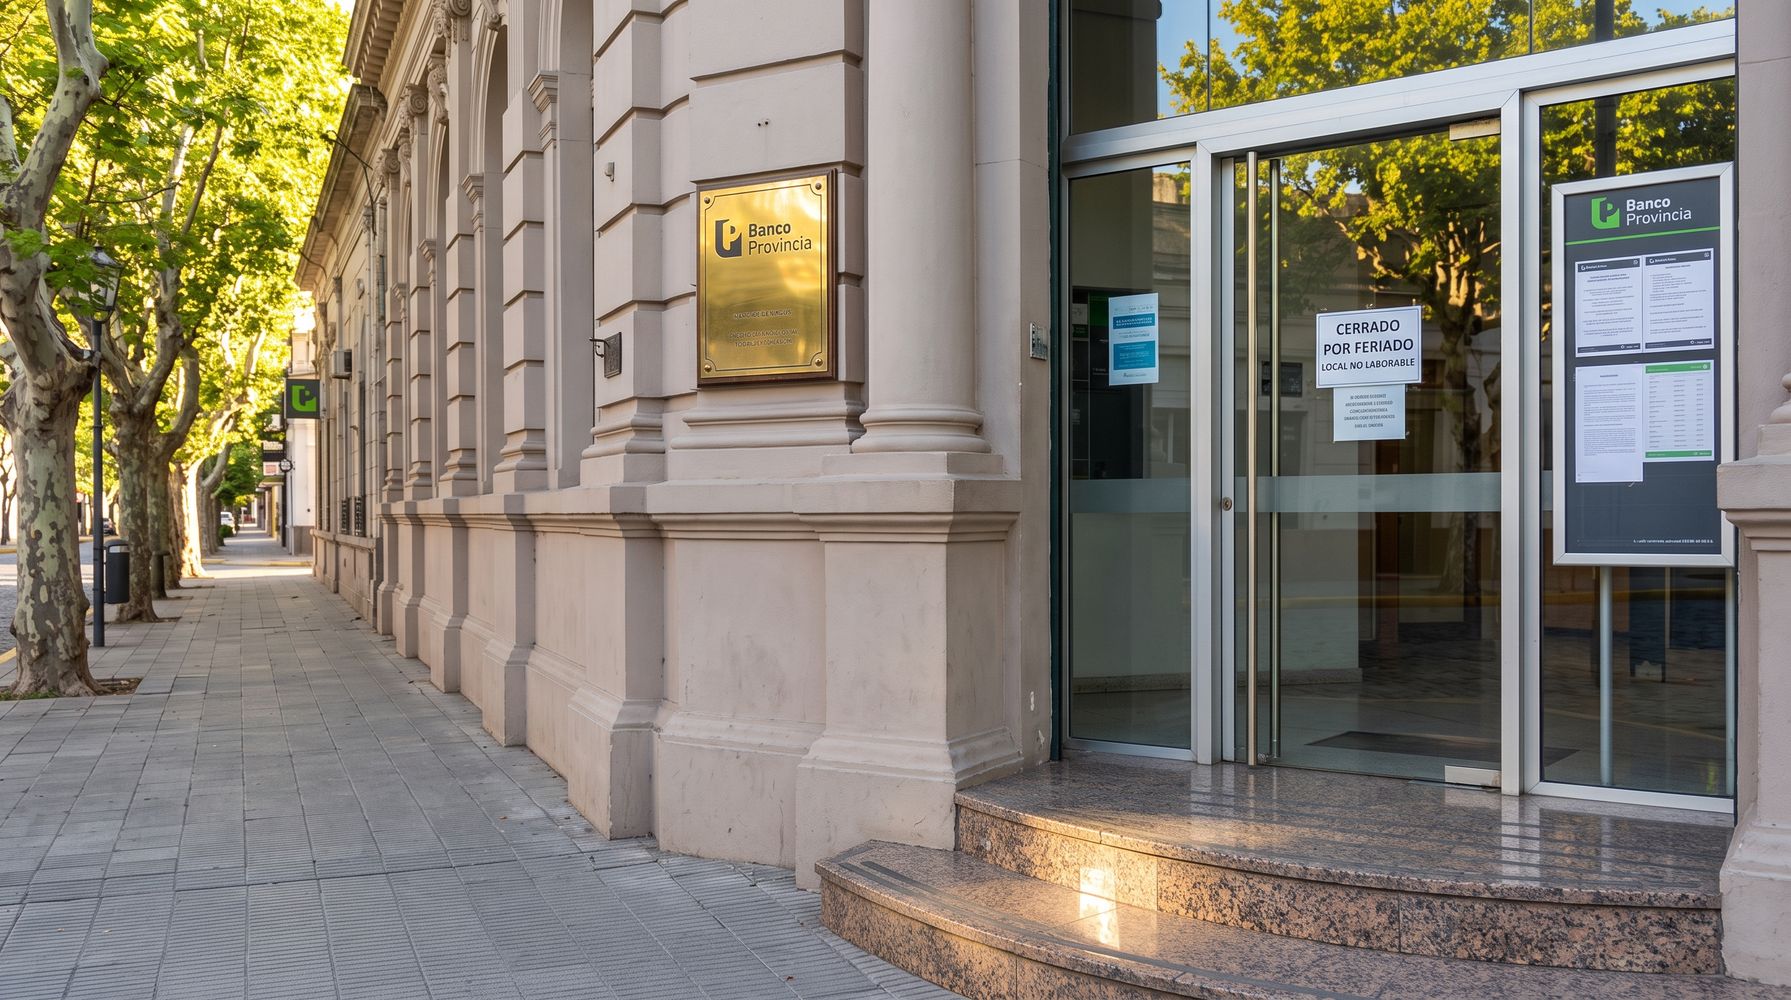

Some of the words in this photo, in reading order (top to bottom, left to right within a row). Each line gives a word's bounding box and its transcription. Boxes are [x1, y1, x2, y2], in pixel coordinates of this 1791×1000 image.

[1626, 198, 1671, 212] Banco
[1626, 208, 1692, 226] Provincia
[748, 223, 791, 237] Banco
[748, 236, 812, 256] Provincia
[1336, 319, 1400, 336] CERRADO
[1323, 343, 1351, 356] POR
[1355, 338, 1414, 354] FERIADO
[1321, 362, 1348, 372] LOCAL
[1349, 361, 1364, 370] NO
[1365, 358, 1415, 369] LABORABLE
